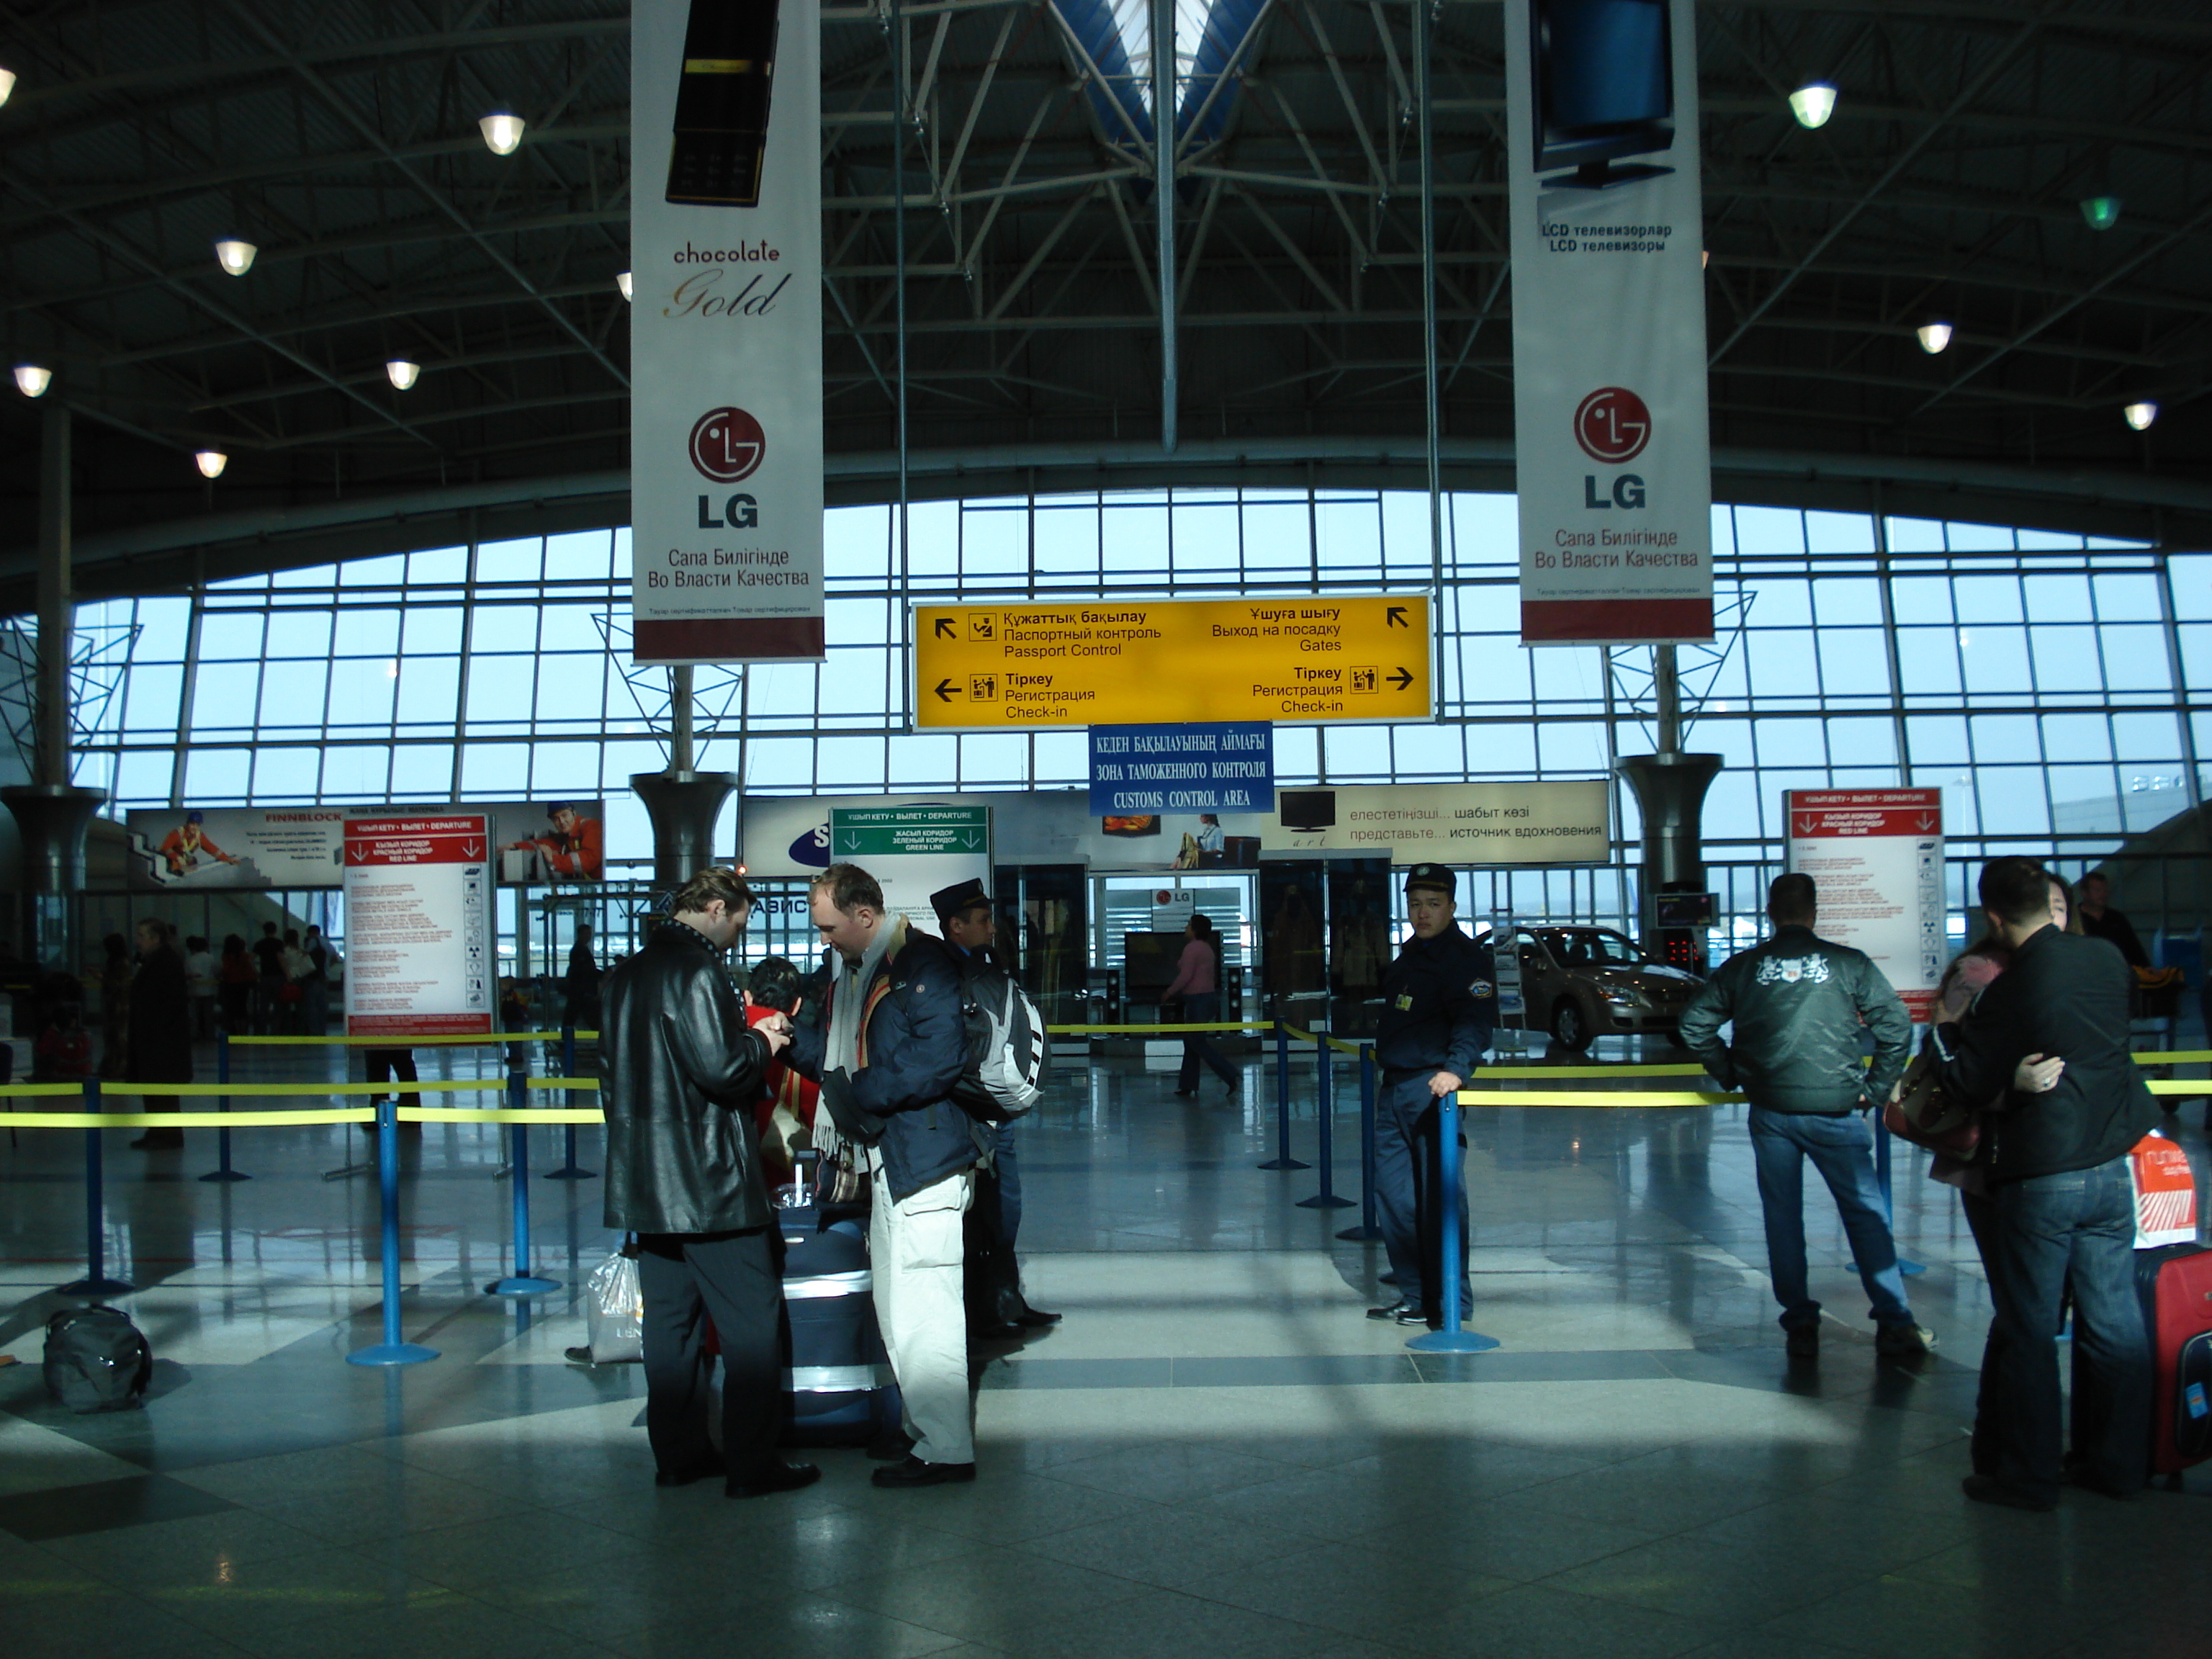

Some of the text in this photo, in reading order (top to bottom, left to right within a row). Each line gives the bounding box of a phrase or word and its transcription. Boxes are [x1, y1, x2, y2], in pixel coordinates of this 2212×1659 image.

[1542, 223, 1672, 238] LCD телевизорлар
[674, 239, 781, 264] chocolate
[1550, 239, 1665, 253] LCD телевизоры
[662, 268, 792, 319] Gold
[1585, 474, 1646, 509] LG
[698, 493, 758, 529] LG
[1555, 528, 1678, 548] Сапа Билігінде
[669, 547, 789, 567] Сапа Билігінде
[1535, 549, 1699, 570] Во Власти Качества
[649, 569, 809, 588] Во Власти Качества
[1004, 611, 1146, 627] Құжаттық бақылау
[1250, 608, 1340, 622] Ұшуға шығу
[1004, 627, 1161, 642] Паспортный контроль
[1213, 624, 1341, 638] Выход на посадку
[1004, 644, 1121, 659] Passport Control
[1300, 639, 1341, 651] Gates
[1006, 673, 1053, 688] Тіркеу
[1294, 667, 1341, 682] Тіркеу
[1005, 690, 1095, 703] Регистрация
[1252, 685, 1343, 698] Регистрация
[1006, 706, 1067, 719] Check-in
[1281, 700, 1343, 713] Check-in
[1096, 729, 1265, 755] КЕДЕН БАҚЫЛАУЫНЫҢ АЙМАҒЫ
[1096, 761, 1267, 781] ЗОНА ТАМОЖЕННОГО КОНТРОЛЯ
[1113, 790, 1251, 809] CUSTOMS CONTROL AREA
[265, 812, 342, 823] FINNBLOCK
[871, 812, 890, 821] КЕТУ
[896, 811, 922, 820] ВЫЛЕТ
[927, 811, 972, 820] DEPARTURE
[1455, 807, 1500, 819] шабыт
[1503, 806, 1529, 818] көзі
[430, 821, 472, 830] DEPARTURE
[1450, 829, 1511, 838] источник
[1515, 826, 1601, 839] вдохновения
[1174, 893, 1190, 902] LG
